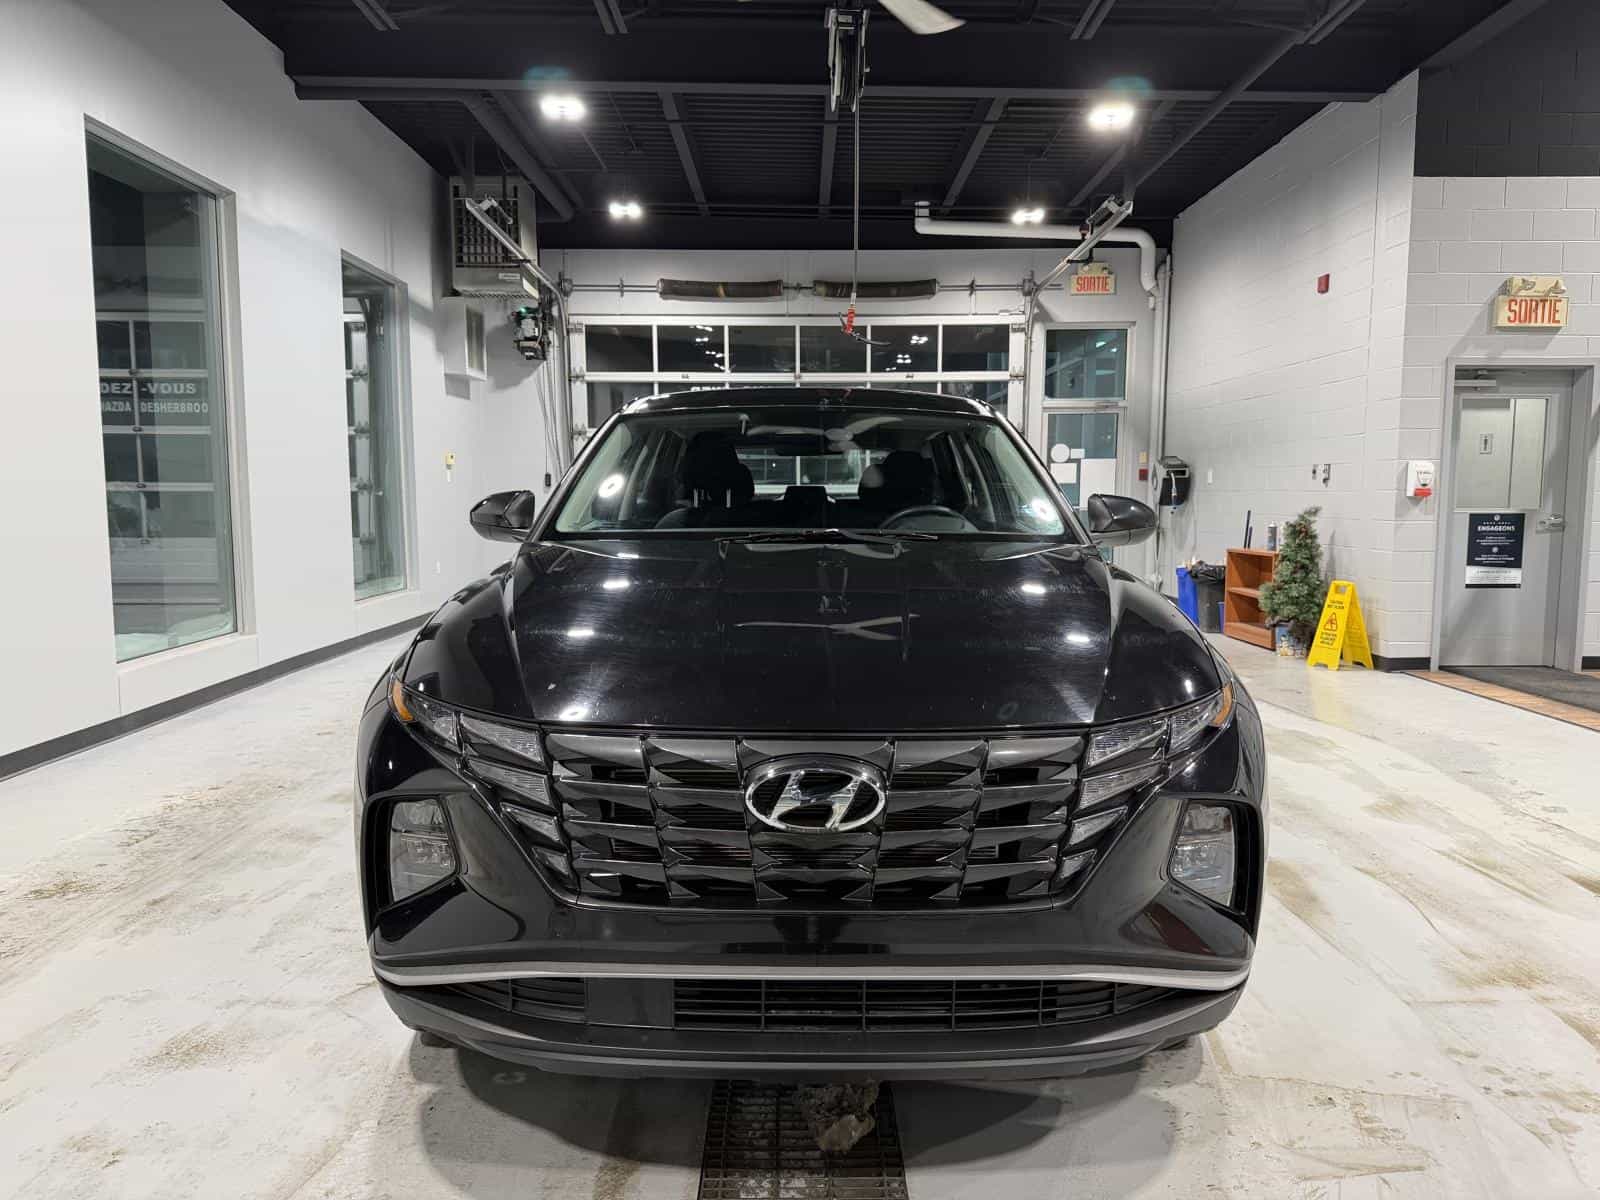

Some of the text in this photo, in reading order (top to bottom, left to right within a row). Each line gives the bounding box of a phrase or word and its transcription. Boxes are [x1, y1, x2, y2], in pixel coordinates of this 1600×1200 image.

[1076, 276, 1111, 292] SORTIE
[1507, 298, 1562, 324] SORTIE
[102, 401, 132, 413] AZDA
